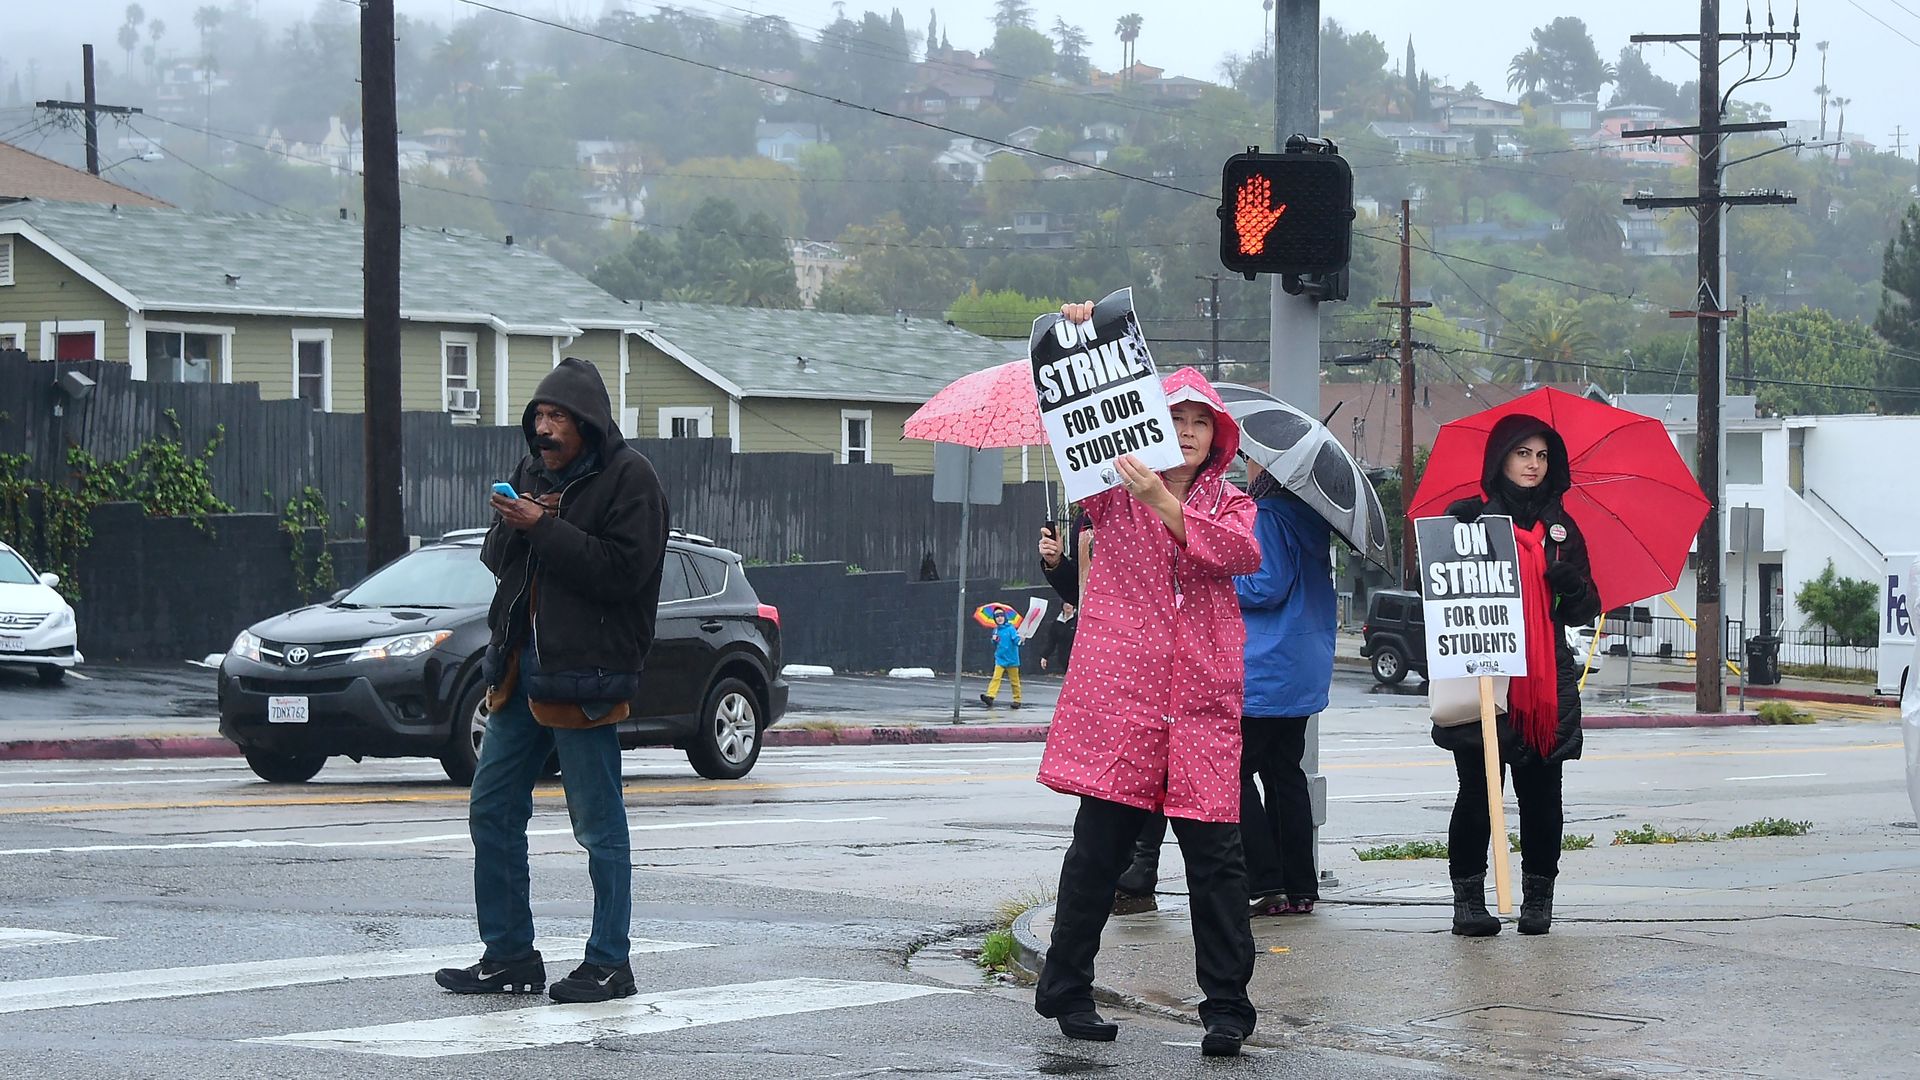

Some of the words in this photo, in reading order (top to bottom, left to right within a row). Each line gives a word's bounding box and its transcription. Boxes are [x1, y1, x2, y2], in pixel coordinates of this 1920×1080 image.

[1055, 316, 1097, 349] ON
[1039, 338, 1144, 404] STRIKE
[1063, 404, 1100, 438] FOR
[1100, 390, 1145, 424] OUR
[1066, 418, 1164, 472] STUDENTS
[1453, 522, 1488, 556] ON
[1429, 560, 1515, 596] STRIKE
[1444, 606, 1475, 627] FOR
[1478, 605, 1509, 626] OUR
[1438, 632, 1517, 656] STUDENTS
[271, 706, 306, 719] 7DNX762
